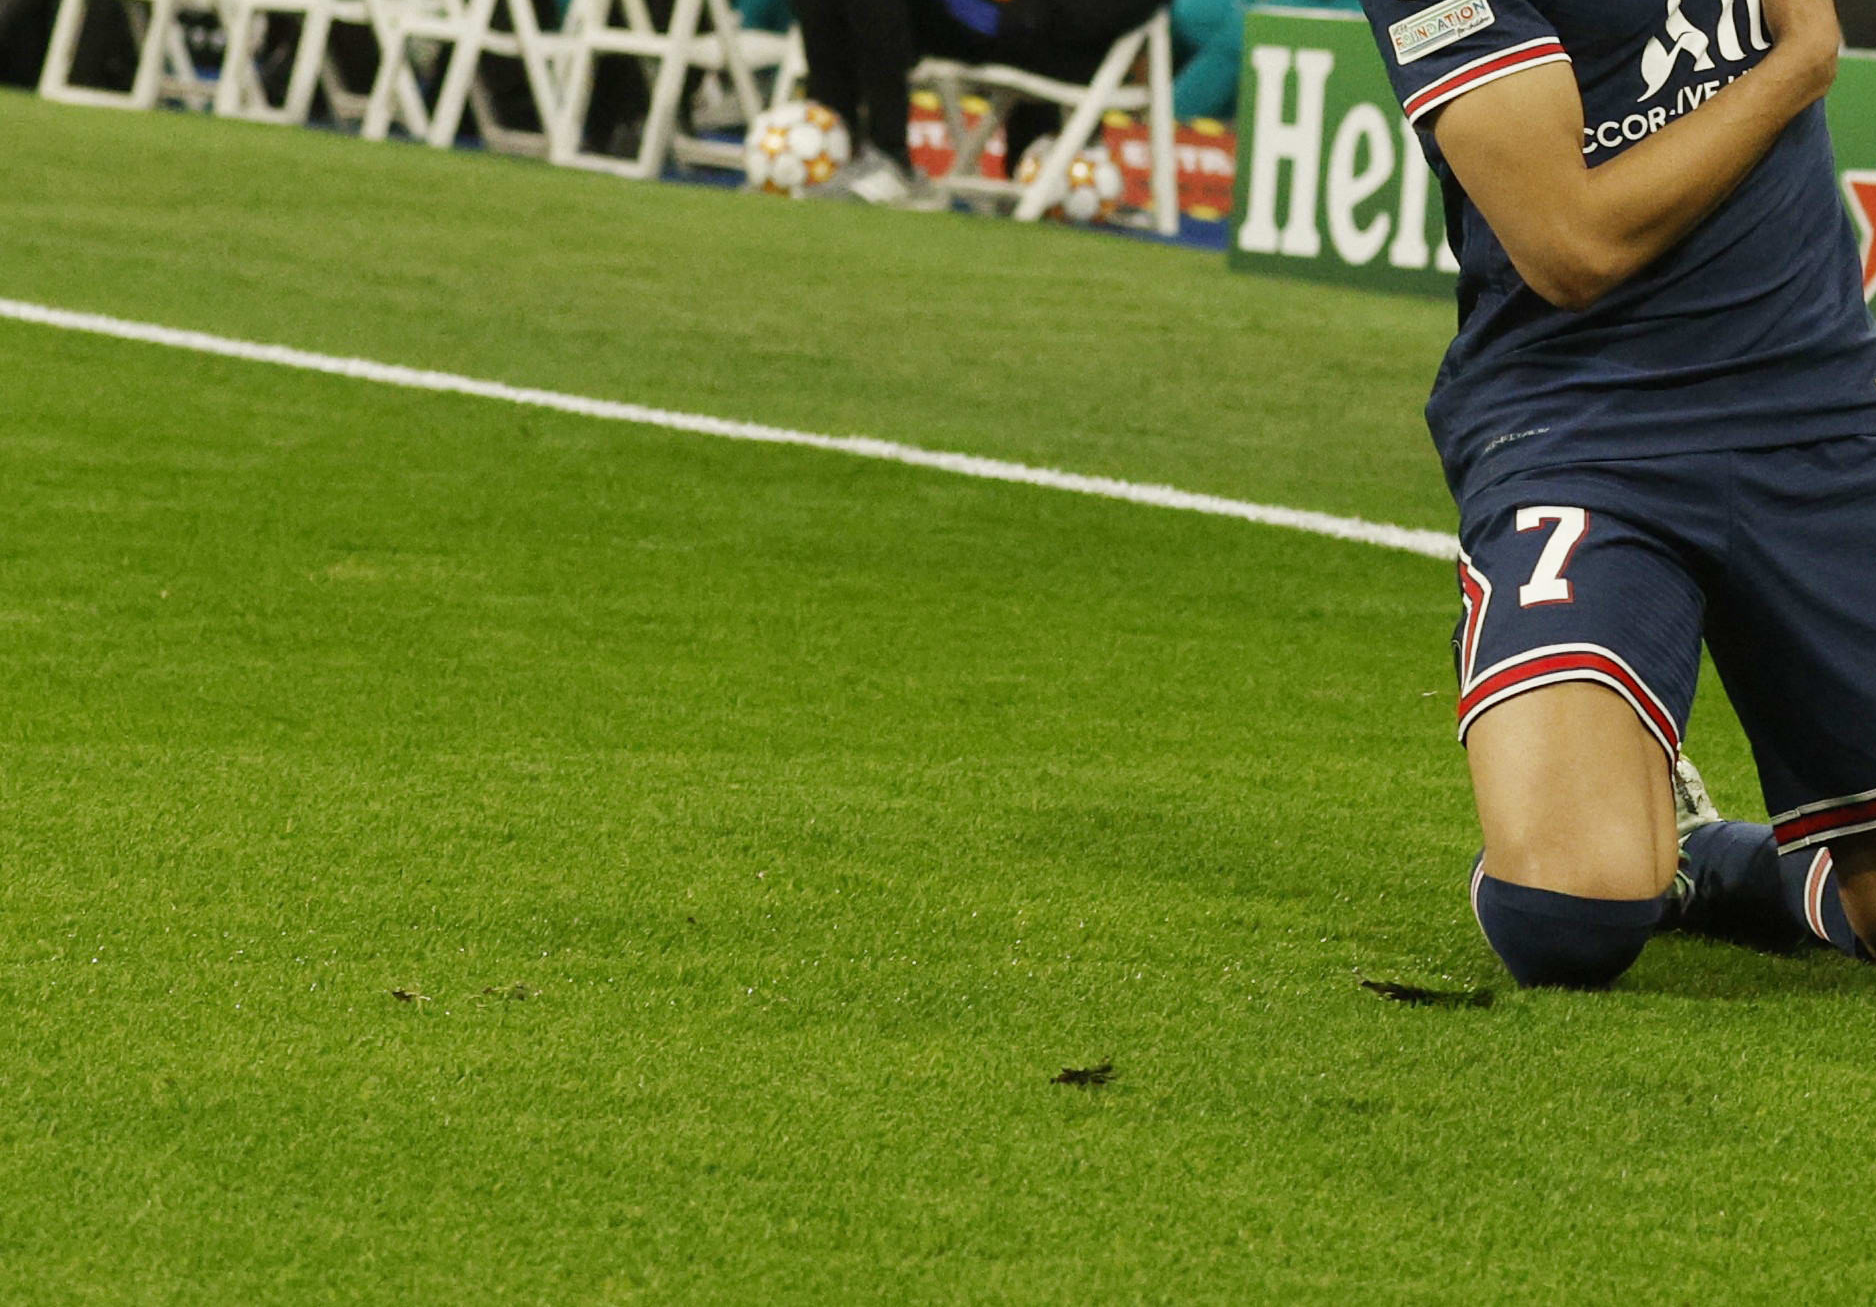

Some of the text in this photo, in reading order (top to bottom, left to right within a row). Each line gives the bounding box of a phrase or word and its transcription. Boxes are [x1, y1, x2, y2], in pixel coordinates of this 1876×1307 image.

[1582, 80, 1721, 154] CCOR IVE
[1515, 505, 1592, 610] 7
